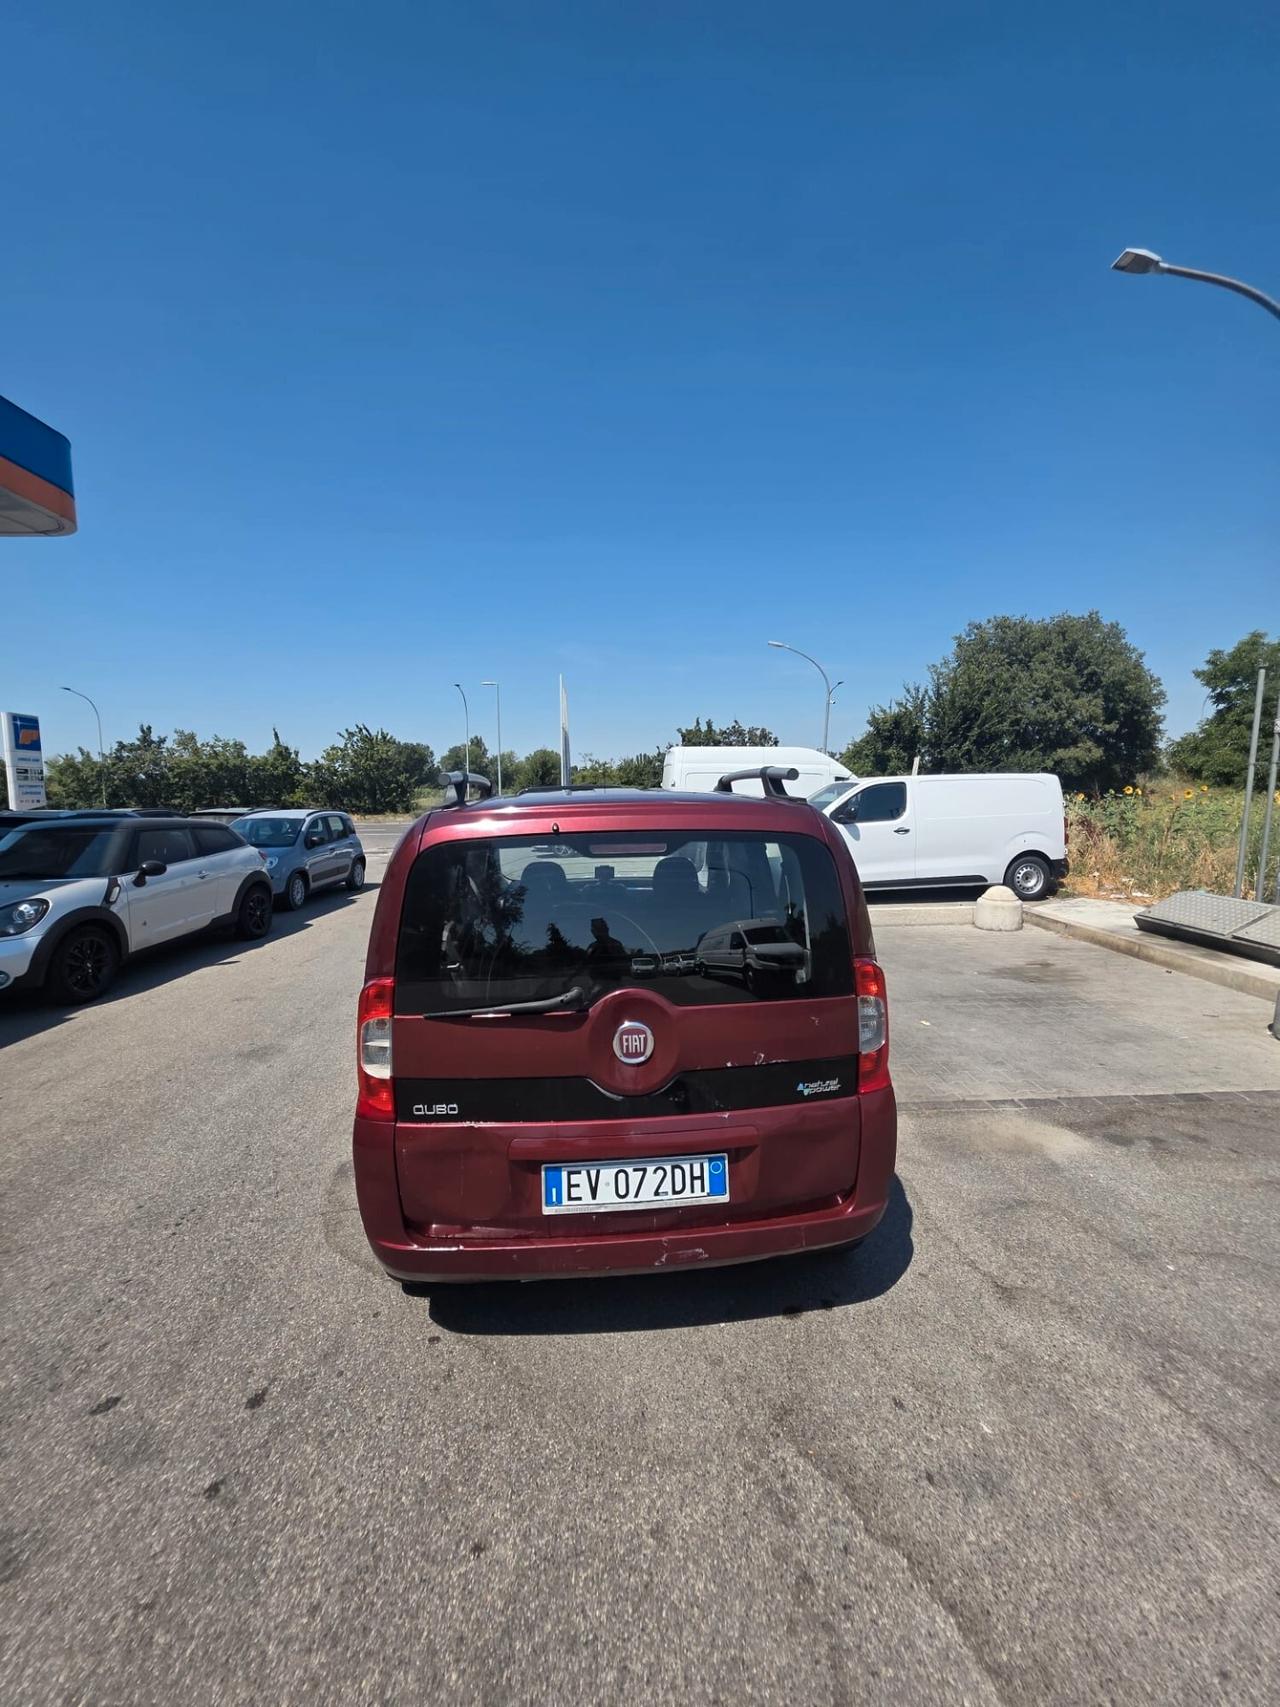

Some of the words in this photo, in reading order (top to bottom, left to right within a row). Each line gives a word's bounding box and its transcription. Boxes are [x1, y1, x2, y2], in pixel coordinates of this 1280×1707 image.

[622, 1034, 646, 1054] FIAT
[804, 1077, 839, 1089] natural
[808, 1084, 841, 1095] power
[412, 1103, 459, 1115] QUBO
[566, 1168, 601, 1202] EV
[614, 1161, 706, 1199] 072DH
